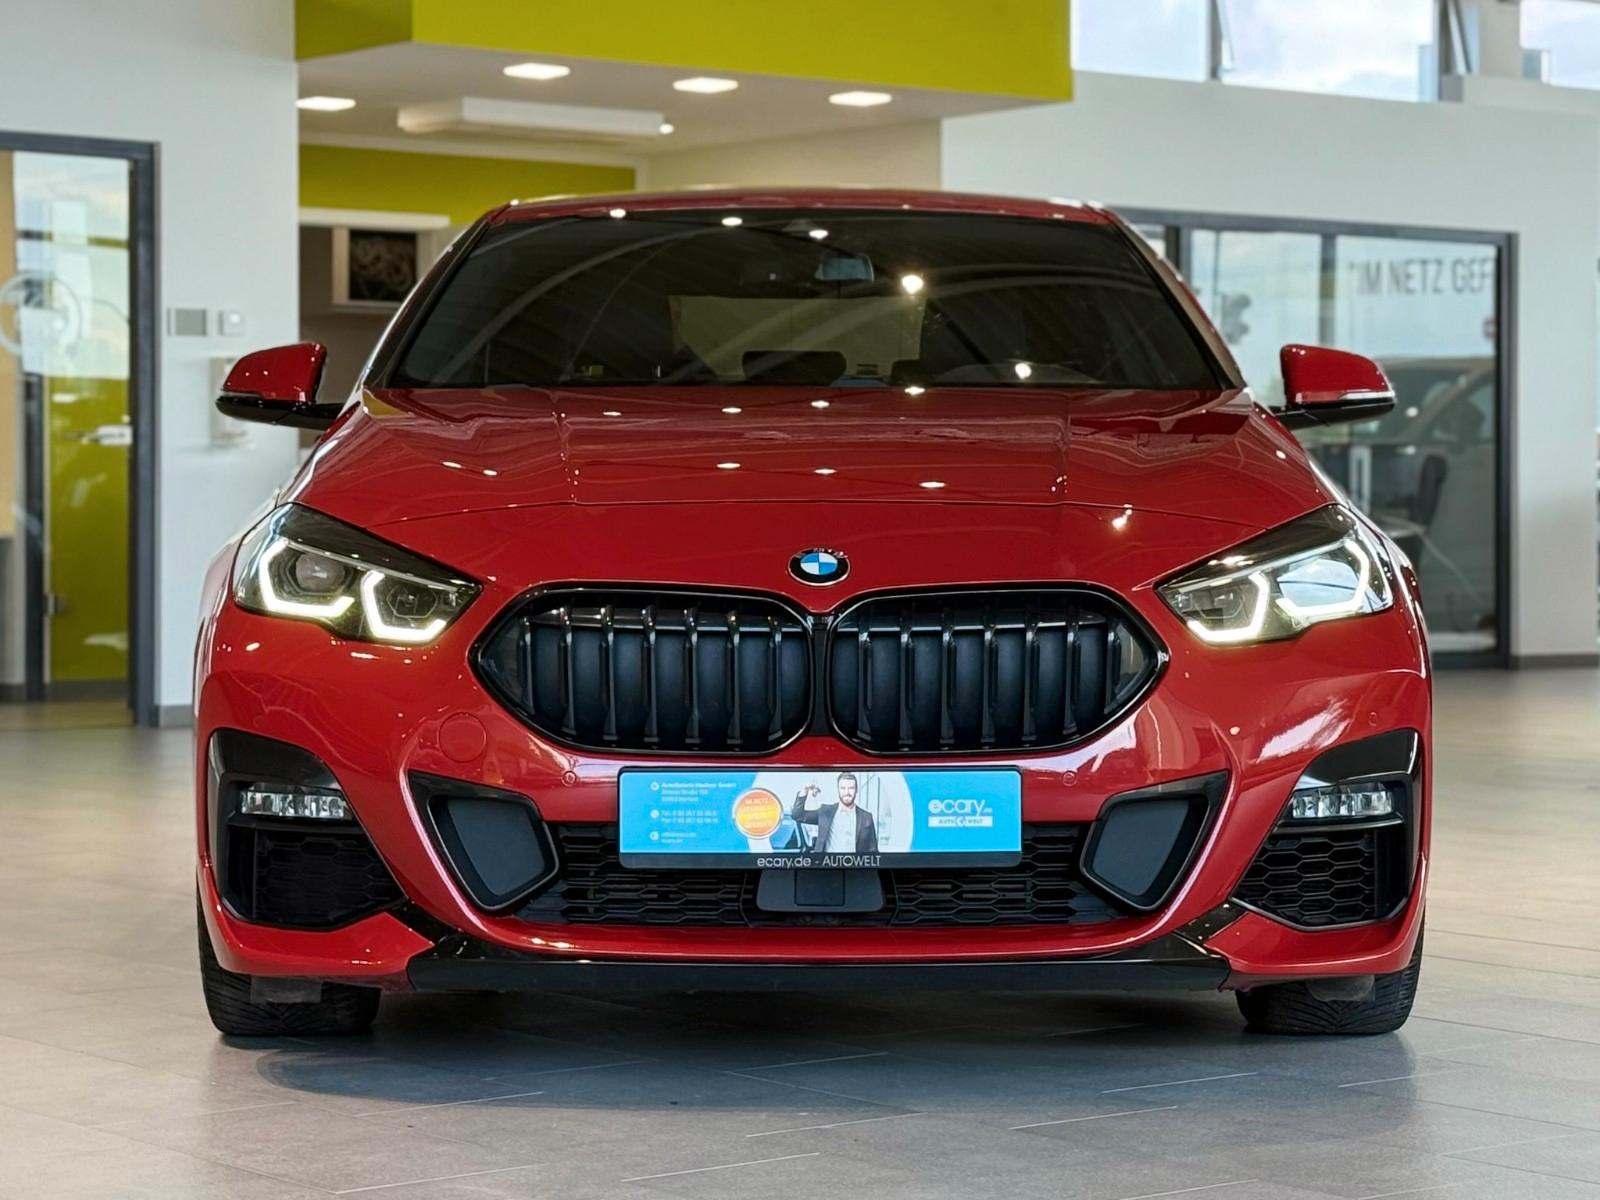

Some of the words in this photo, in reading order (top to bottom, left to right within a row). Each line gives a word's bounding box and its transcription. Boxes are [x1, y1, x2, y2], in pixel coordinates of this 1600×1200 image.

[1387, 258, 1444, 294] NETZ
[757, 855, 812, 869] ecary.de
[822, 855, 881, 867] AUTOWELT
